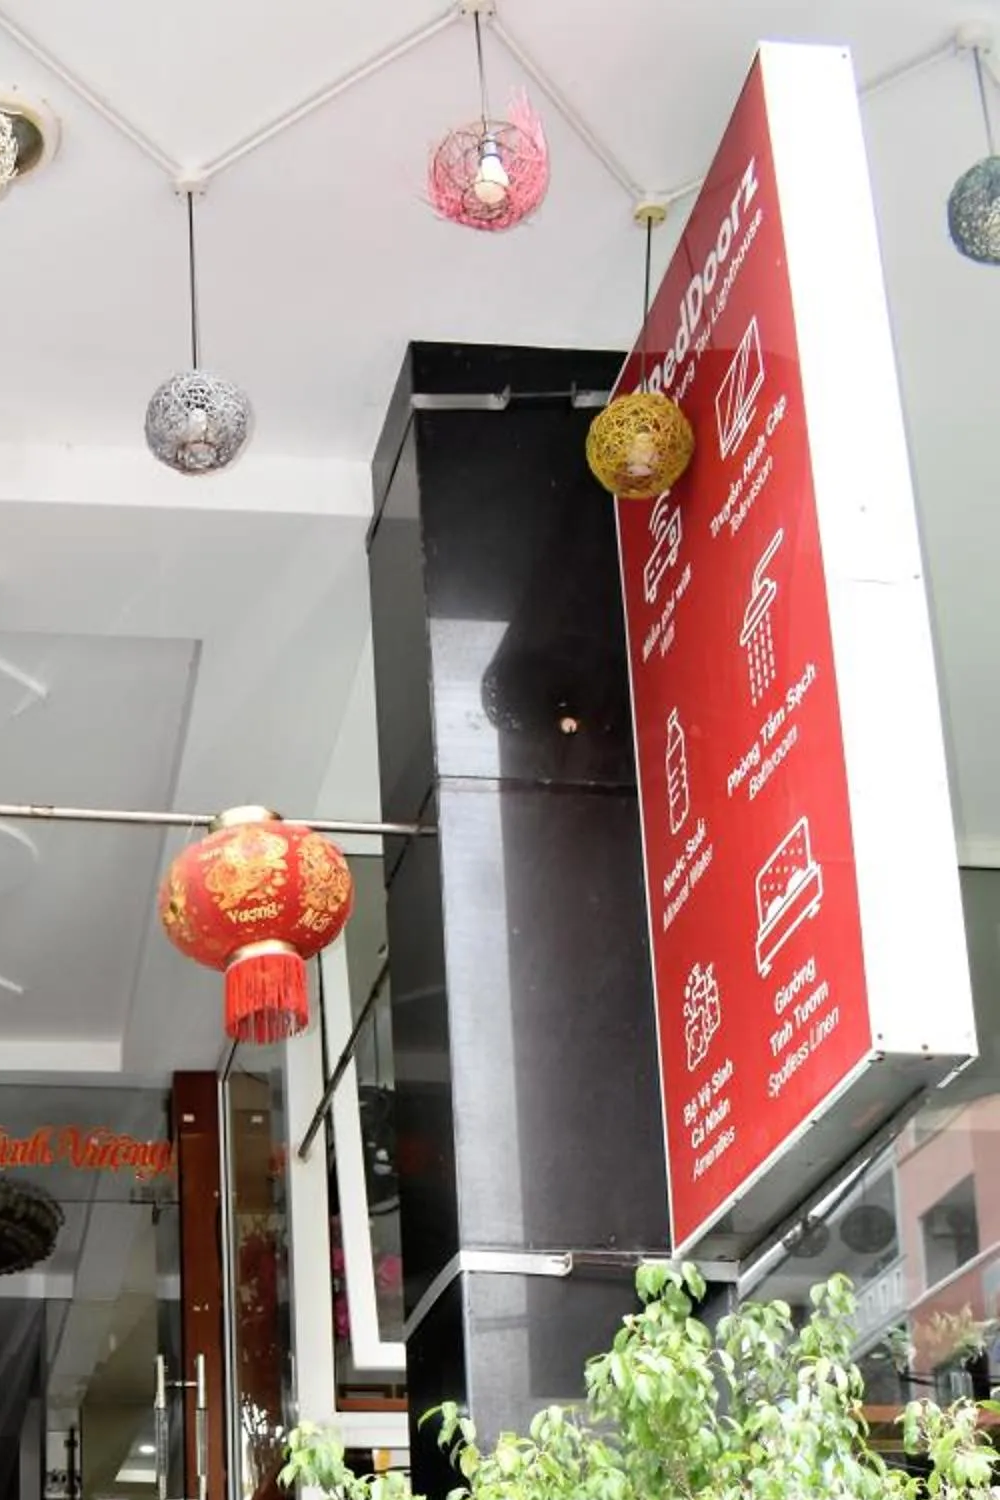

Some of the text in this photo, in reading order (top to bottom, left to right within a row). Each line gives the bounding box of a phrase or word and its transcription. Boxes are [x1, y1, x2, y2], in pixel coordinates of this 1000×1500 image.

[711, 208, 762, 324] Lighthouse
[749, 724, 797, 801] Bathroom
[768, 1007, 839, 1097] Spotless Linen
[694, 1125, 735, 1182] Amenities
